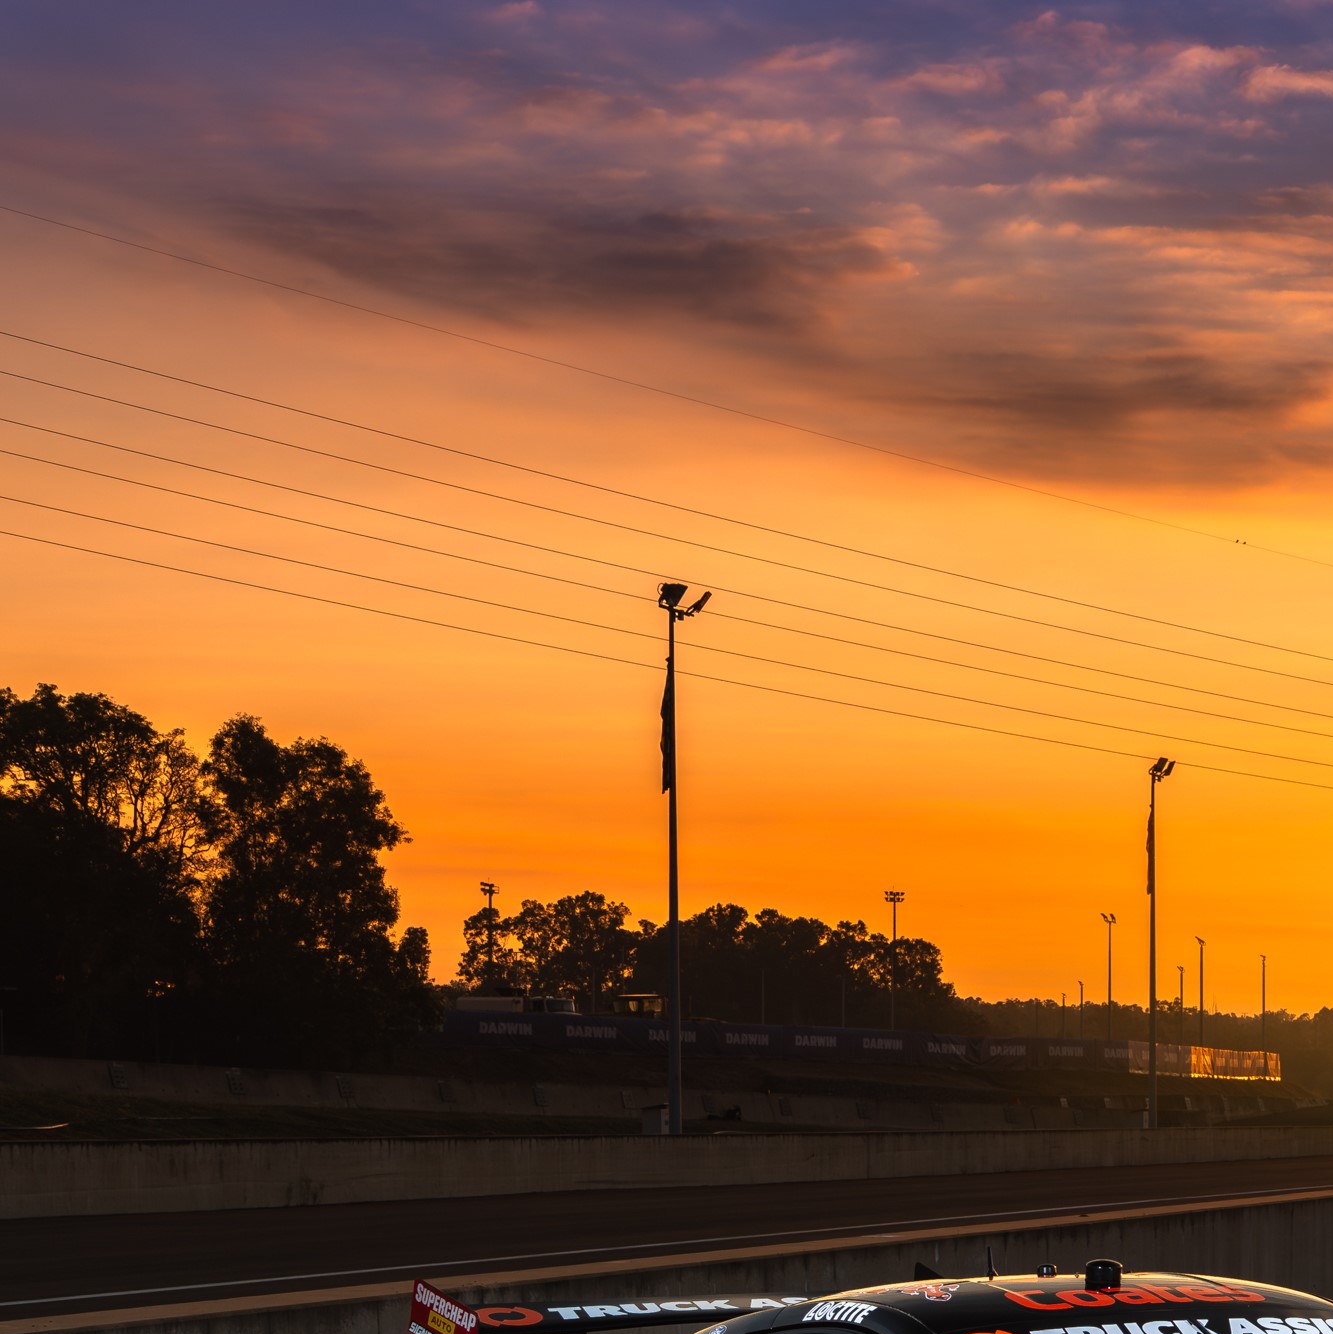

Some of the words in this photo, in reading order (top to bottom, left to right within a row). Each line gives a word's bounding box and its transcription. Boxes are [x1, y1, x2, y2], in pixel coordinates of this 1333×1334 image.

[479, 1022, 533, 1036] DARWIN
[566, 1025, 617, 1039] DARWIN
[725, 1033, 769, 1046] DARWIN
[795, 1035, 837, 1048] DARWIN
[863, 1037, 903, 1051] DARWIN
[990, 1044, 1026, 1057] DARWIN
[1049, 1045, 1084, 1057] DARWIN
[1005, 1284, 1266, 1310] Coates
[414, 1283, 477, 1332] SUPERCHEAP
[547, 1299, 738, 1320] TRUCK
[802, 1301, 878, 1324] LOCTITE
[430, 1316, 452, 1333] AUTO
